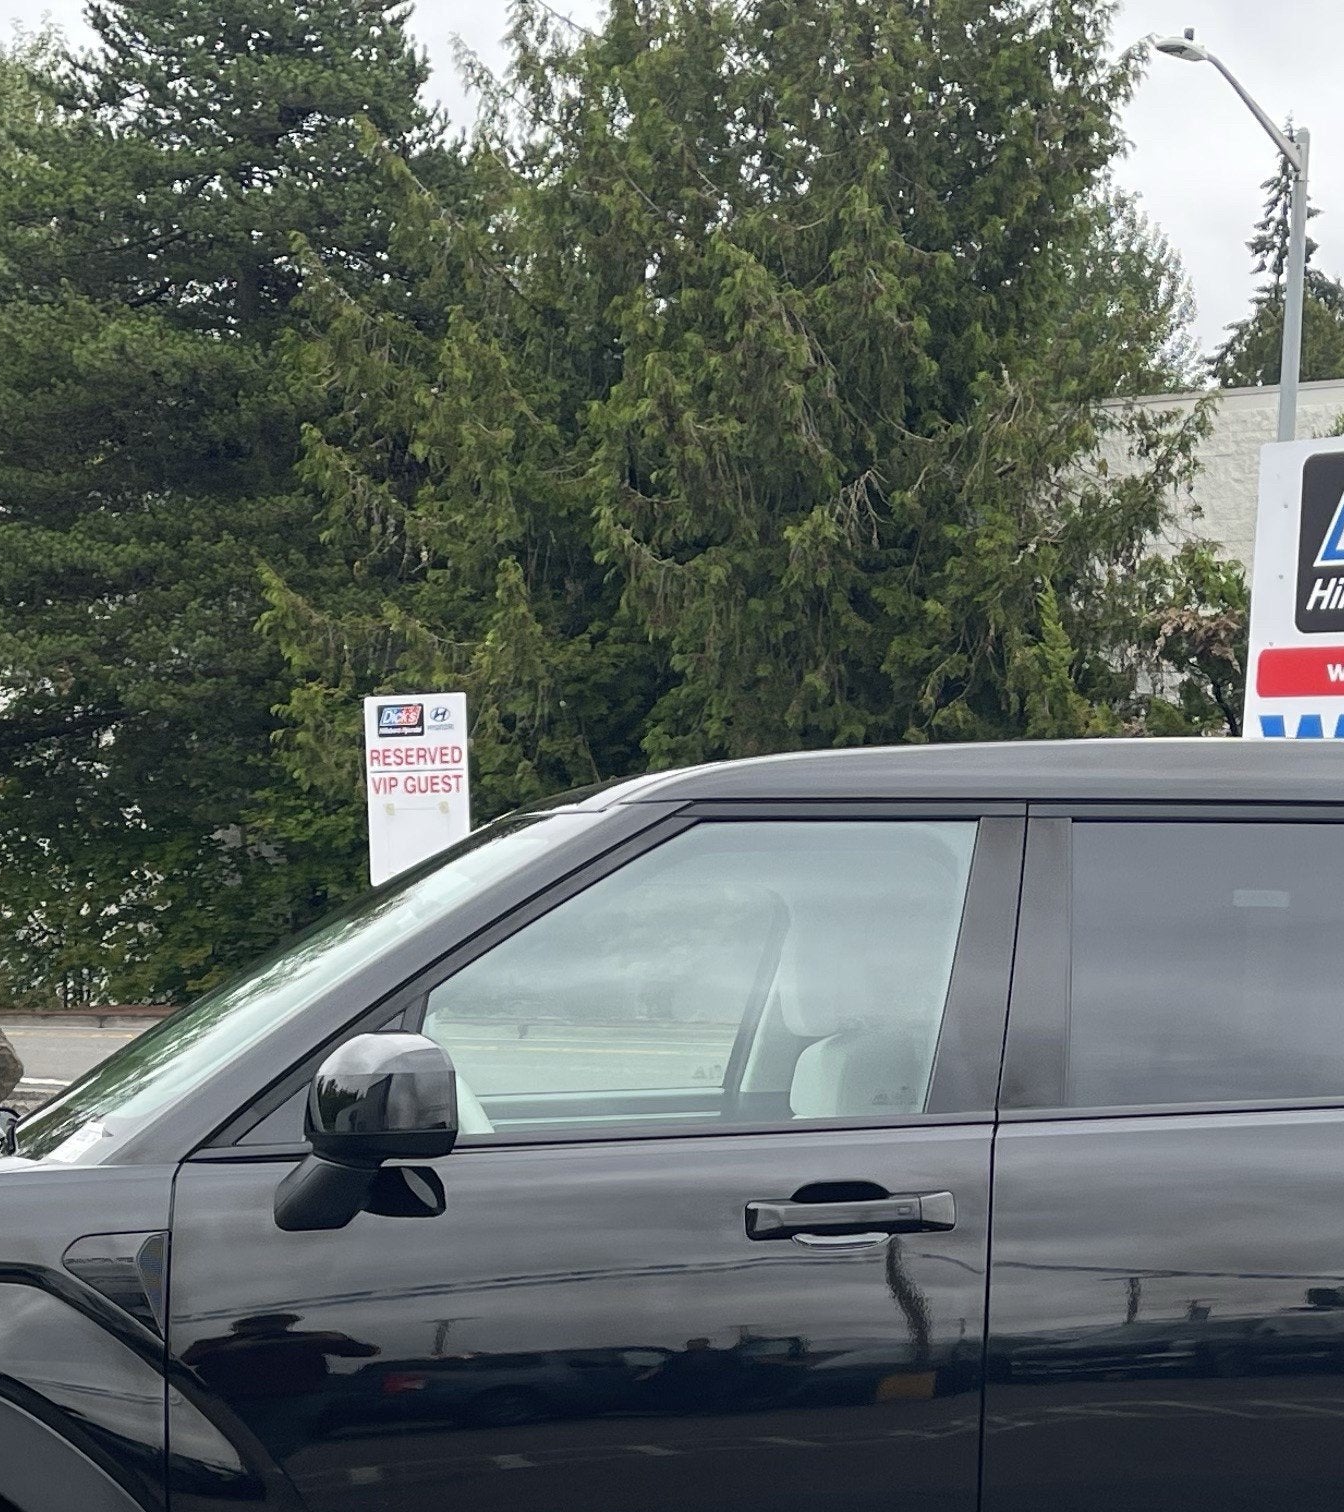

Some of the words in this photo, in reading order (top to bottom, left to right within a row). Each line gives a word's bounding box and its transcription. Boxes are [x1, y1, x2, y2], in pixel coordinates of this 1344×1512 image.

[369, 746, 463, 766] RESERVED
[371, 776, 398, 794] VIP
[404, 775, 463, 794] GUEST
